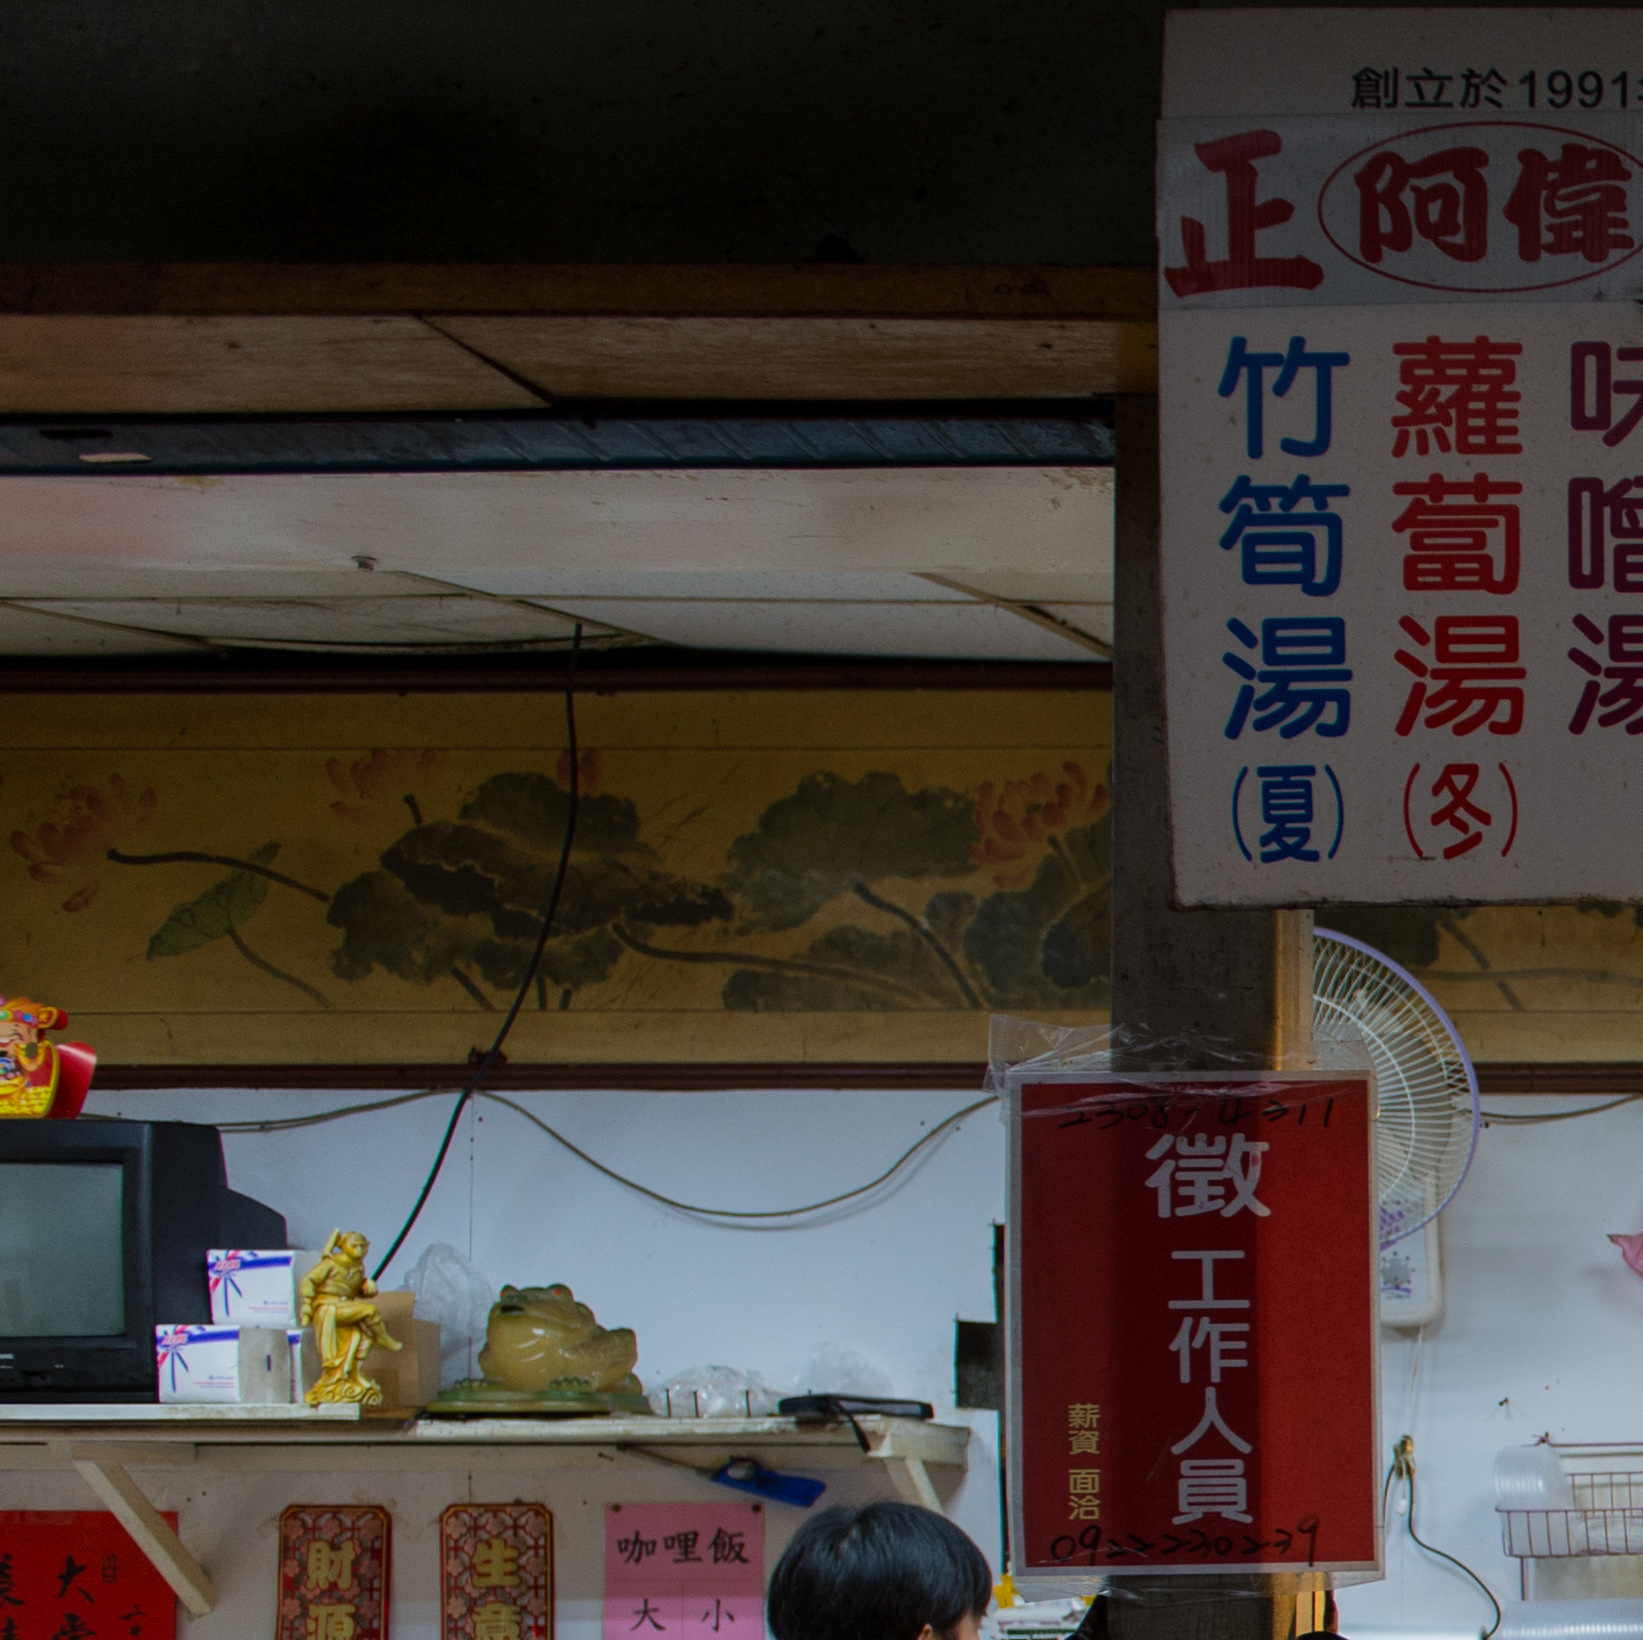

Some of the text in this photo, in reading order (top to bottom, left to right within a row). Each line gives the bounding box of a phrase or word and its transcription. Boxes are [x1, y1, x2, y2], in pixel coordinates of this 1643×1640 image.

[616, 1526, 750, 1565] 咖哩飯
[629, 1597, 735, 1633] 大 小
